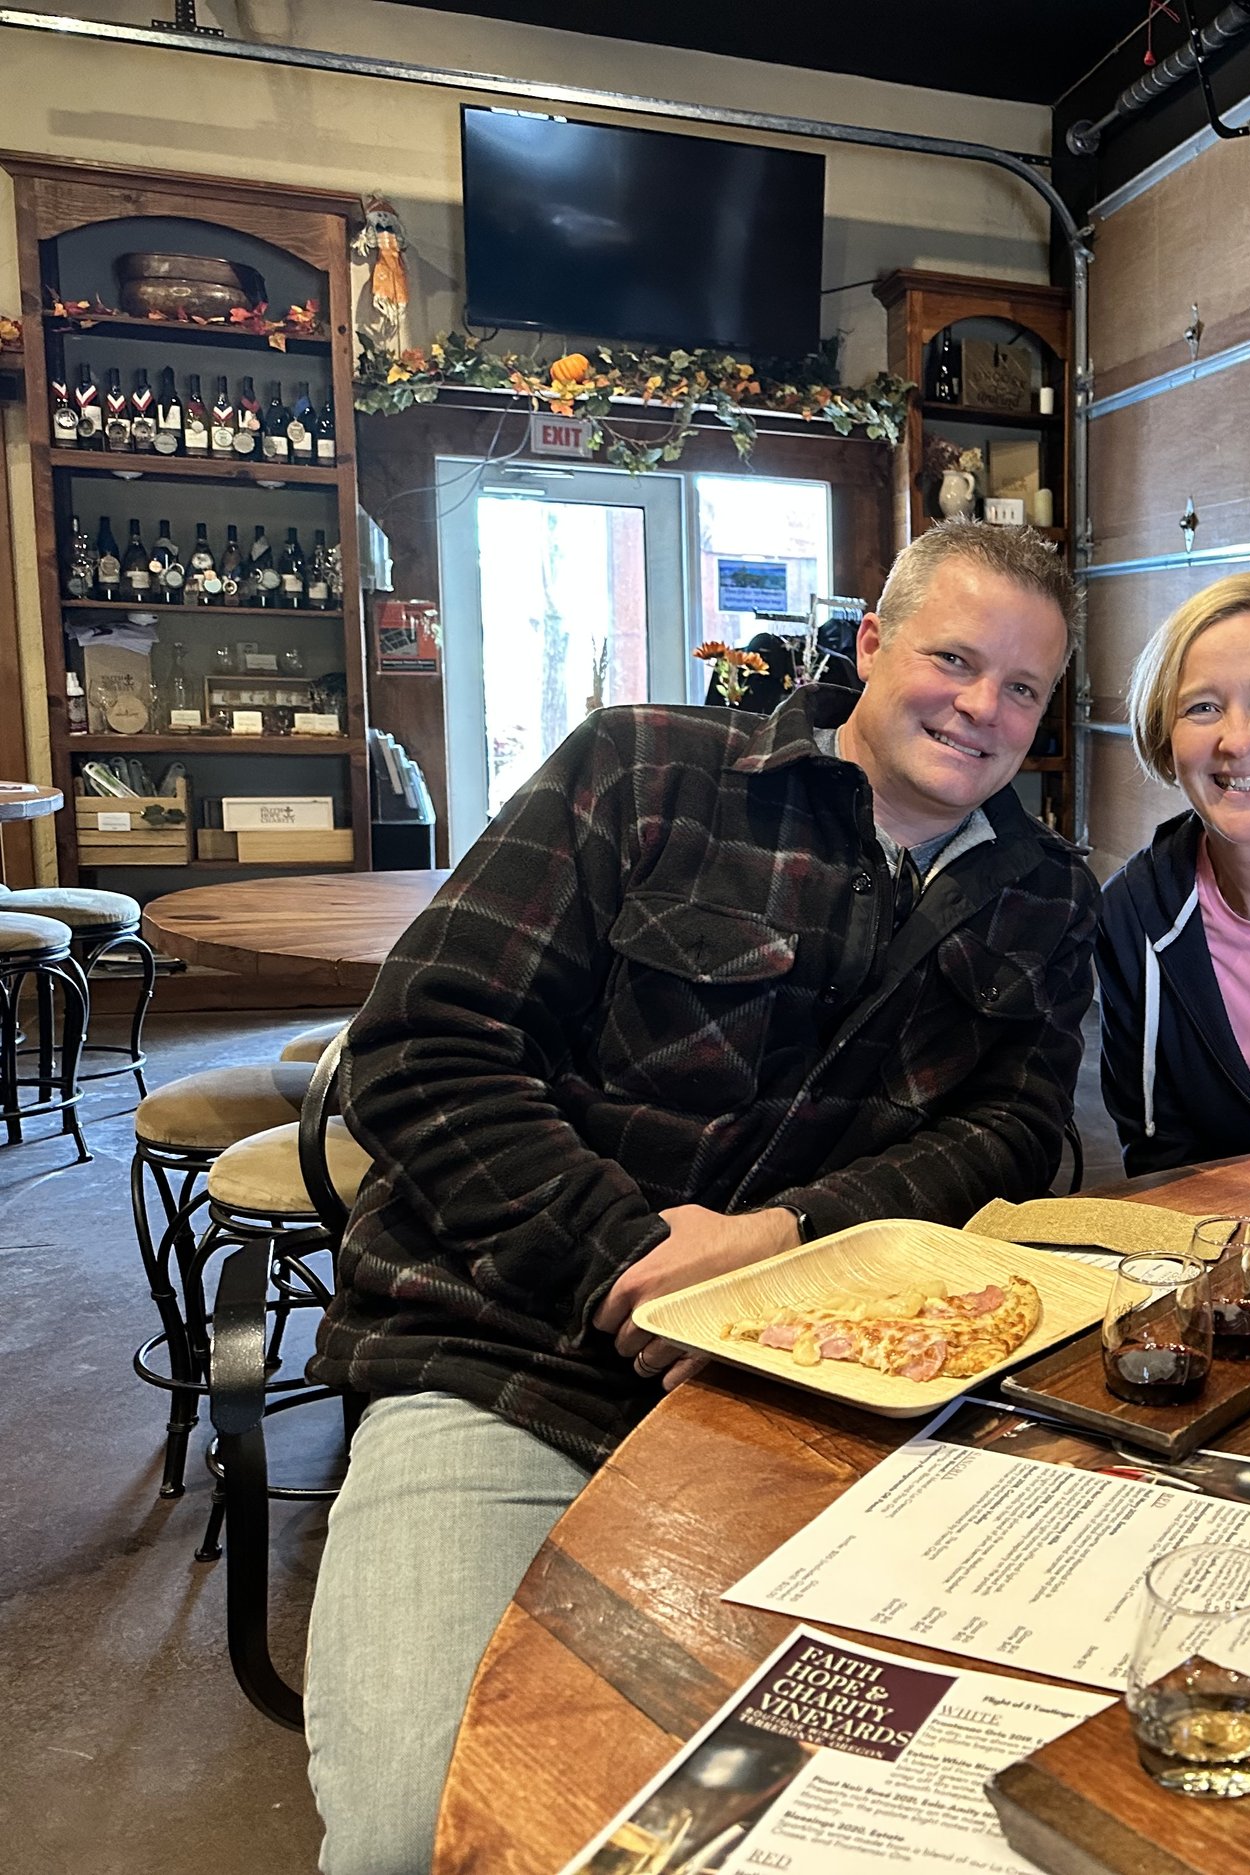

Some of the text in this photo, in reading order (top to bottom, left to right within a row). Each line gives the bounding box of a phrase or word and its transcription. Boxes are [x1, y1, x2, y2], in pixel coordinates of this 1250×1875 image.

[543, 425, 582, 447] EXIT
[940, 1451, 980, 1479] SANGRIA
[800, 1646, 883, 1682] FAITH
[785, 1662, 888, 1701] HOPE &
[773, 1678, 894, 1722] CHARITY
[982, 1695, 1011, 1705] Flight
[1033, 1704, 1074, 1718] Tastings
[760, 1693, 914, 1747] VINEYARDS
[938, 1704, 1003, 1727] WHITE
[808, 1725, 854, 1743] WINERY
[746, 1848, 792, 1871] RED
